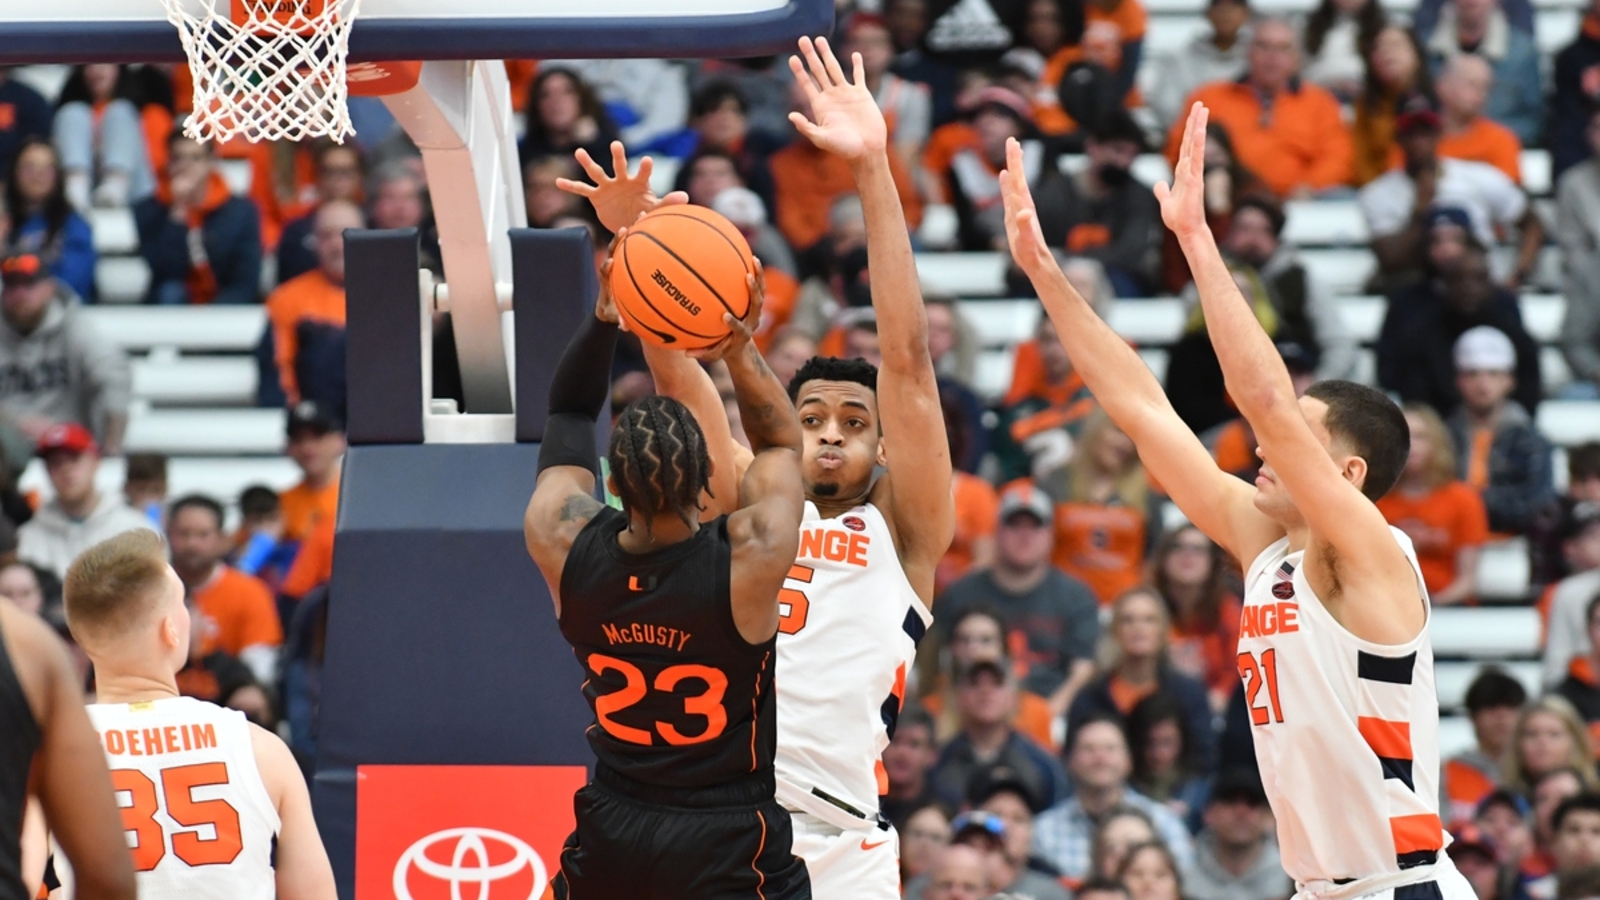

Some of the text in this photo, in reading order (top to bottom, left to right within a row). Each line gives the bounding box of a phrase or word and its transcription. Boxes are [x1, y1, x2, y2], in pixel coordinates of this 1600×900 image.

[244, 1, 312, 15] PALDING
[651, 269, 701, 316] SYRACUSE
[799, 528, 870, 567] NGE
[777, 564, 815, 635] 5
[1240, 602, 1299, 638] ANGE
[602, 623, 691, 651] McGUSTY
[588, 653, 728, 746] 23
[1237, 648, 1284, 726] 21
[104, 723, 217, 756] OEHEIM
[109, 762, 243, 872] 35
